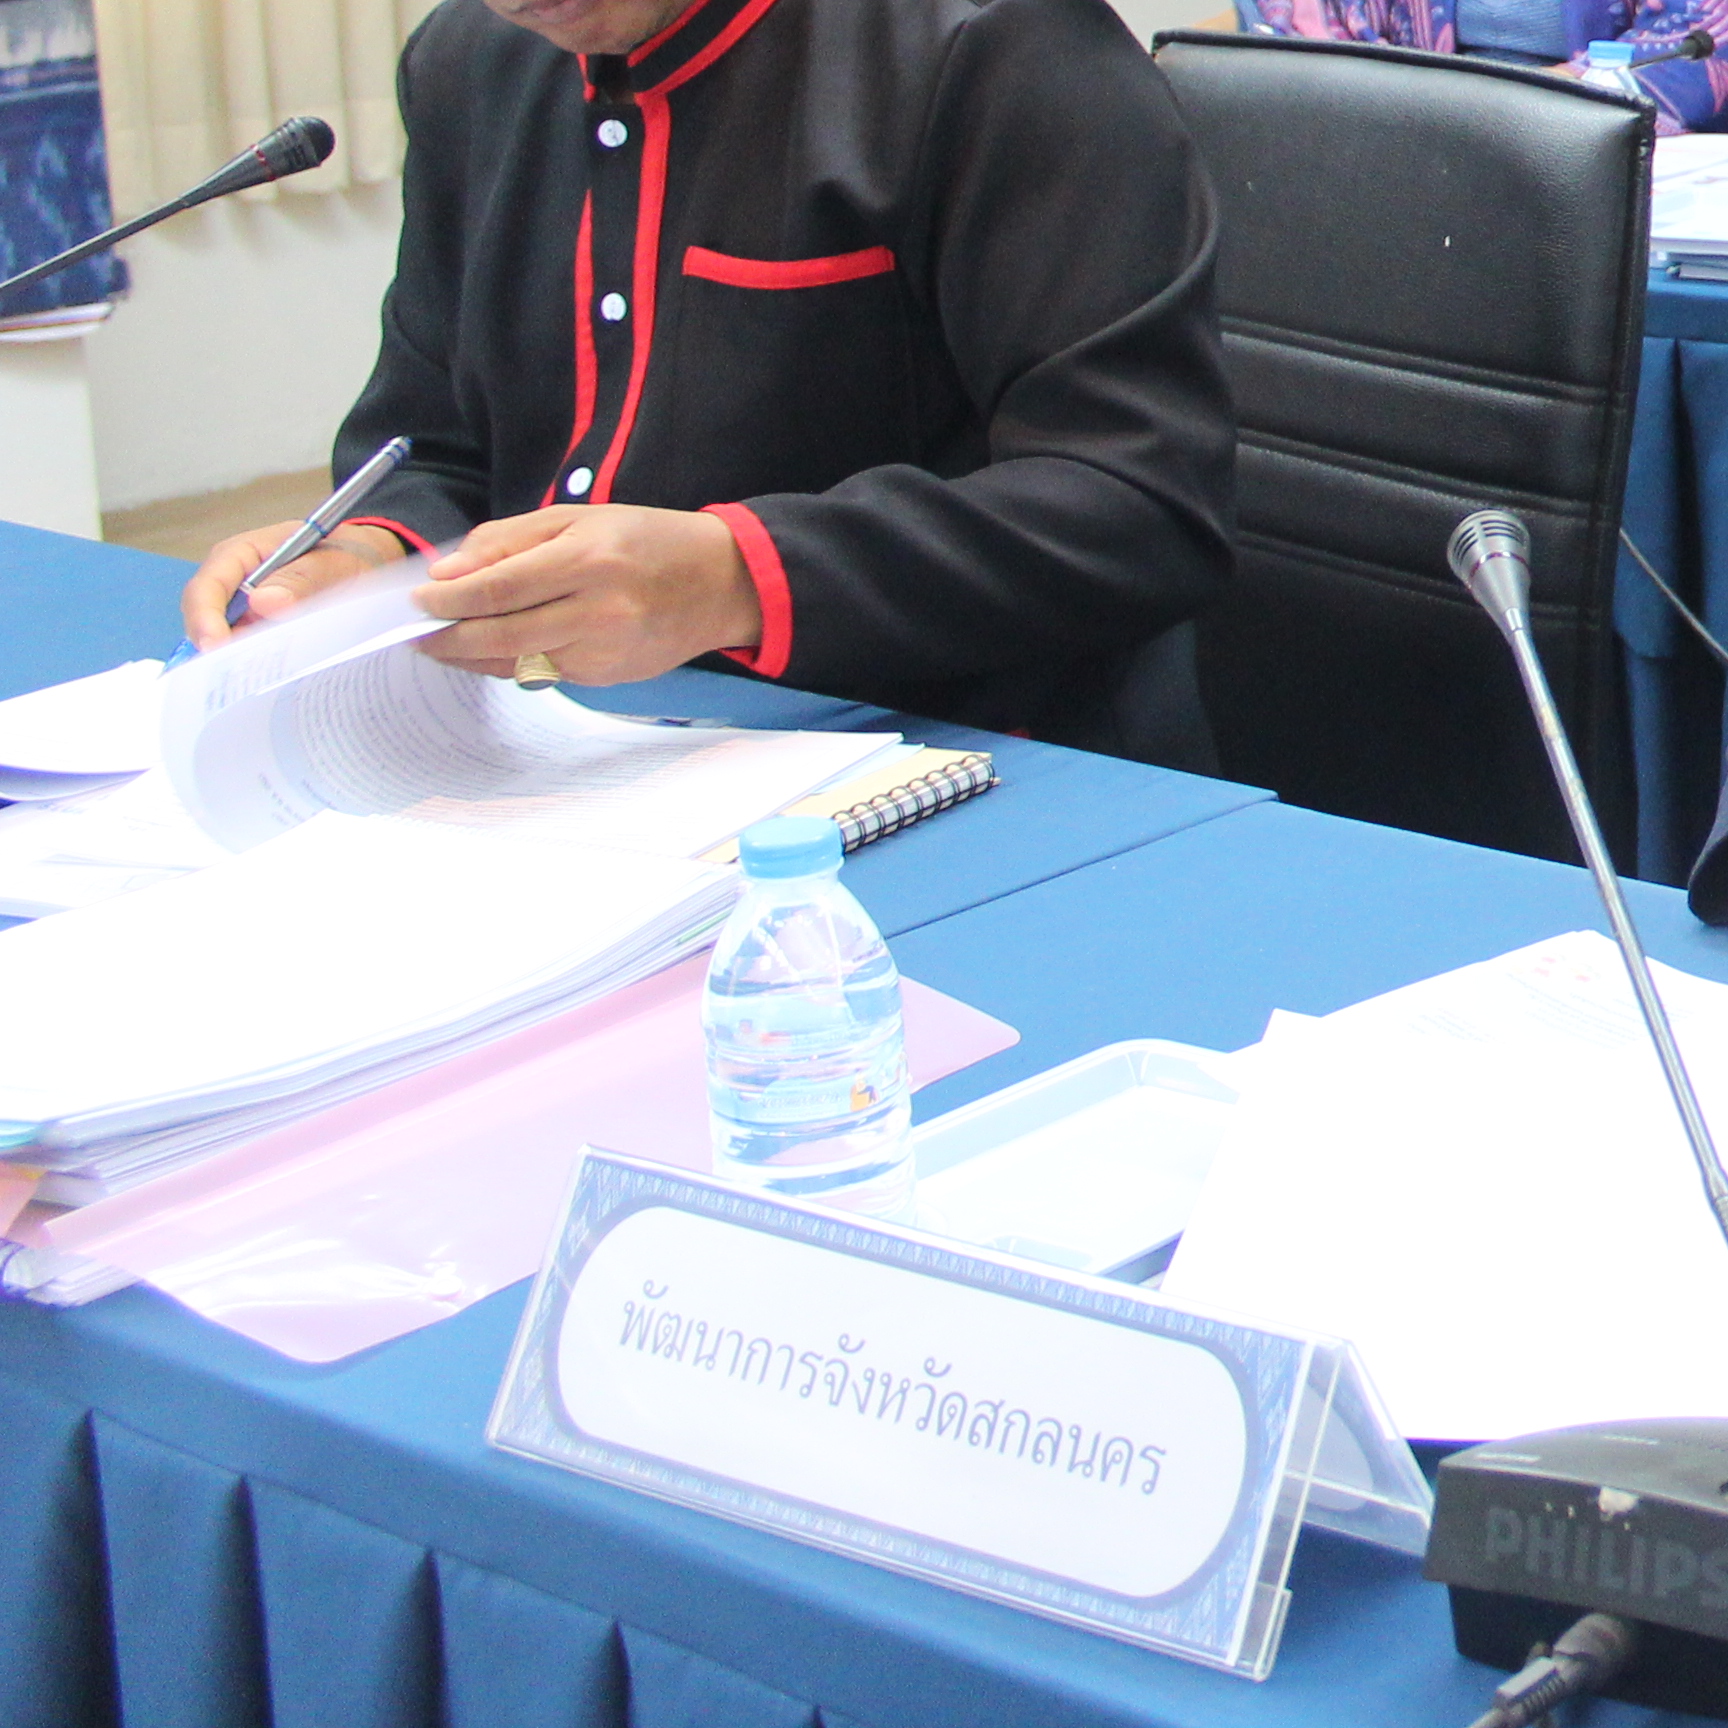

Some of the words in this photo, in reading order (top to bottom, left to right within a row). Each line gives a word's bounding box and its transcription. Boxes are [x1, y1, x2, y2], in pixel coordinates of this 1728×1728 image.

[618, 1279, 1167, 1496] พัฒนาการจังหวัดสกลนคร
